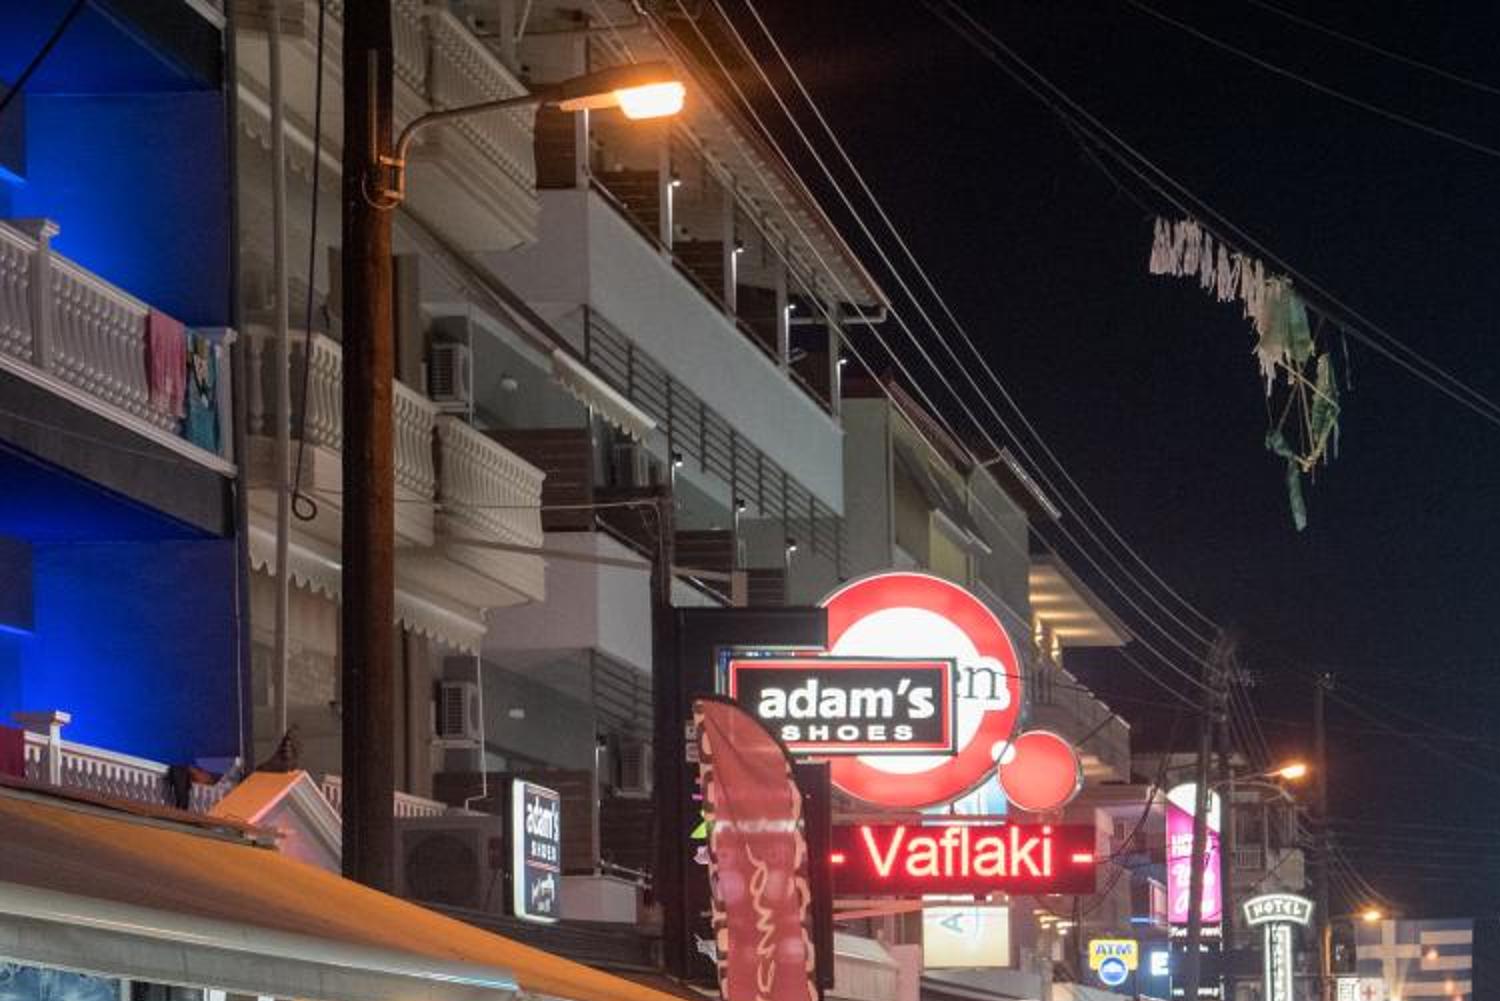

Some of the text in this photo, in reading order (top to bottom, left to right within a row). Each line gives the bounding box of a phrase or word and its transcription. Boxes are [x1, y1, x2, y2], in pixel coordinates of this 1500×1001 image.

[757, 678, 935, 721] adam's
[780, 725, 914, 742] SHOES
[526, 795, 560, 843] adam's
[860, 825, 1053, 878] Vaflaki
[1252, 900, 1302, 917] HOTEL
